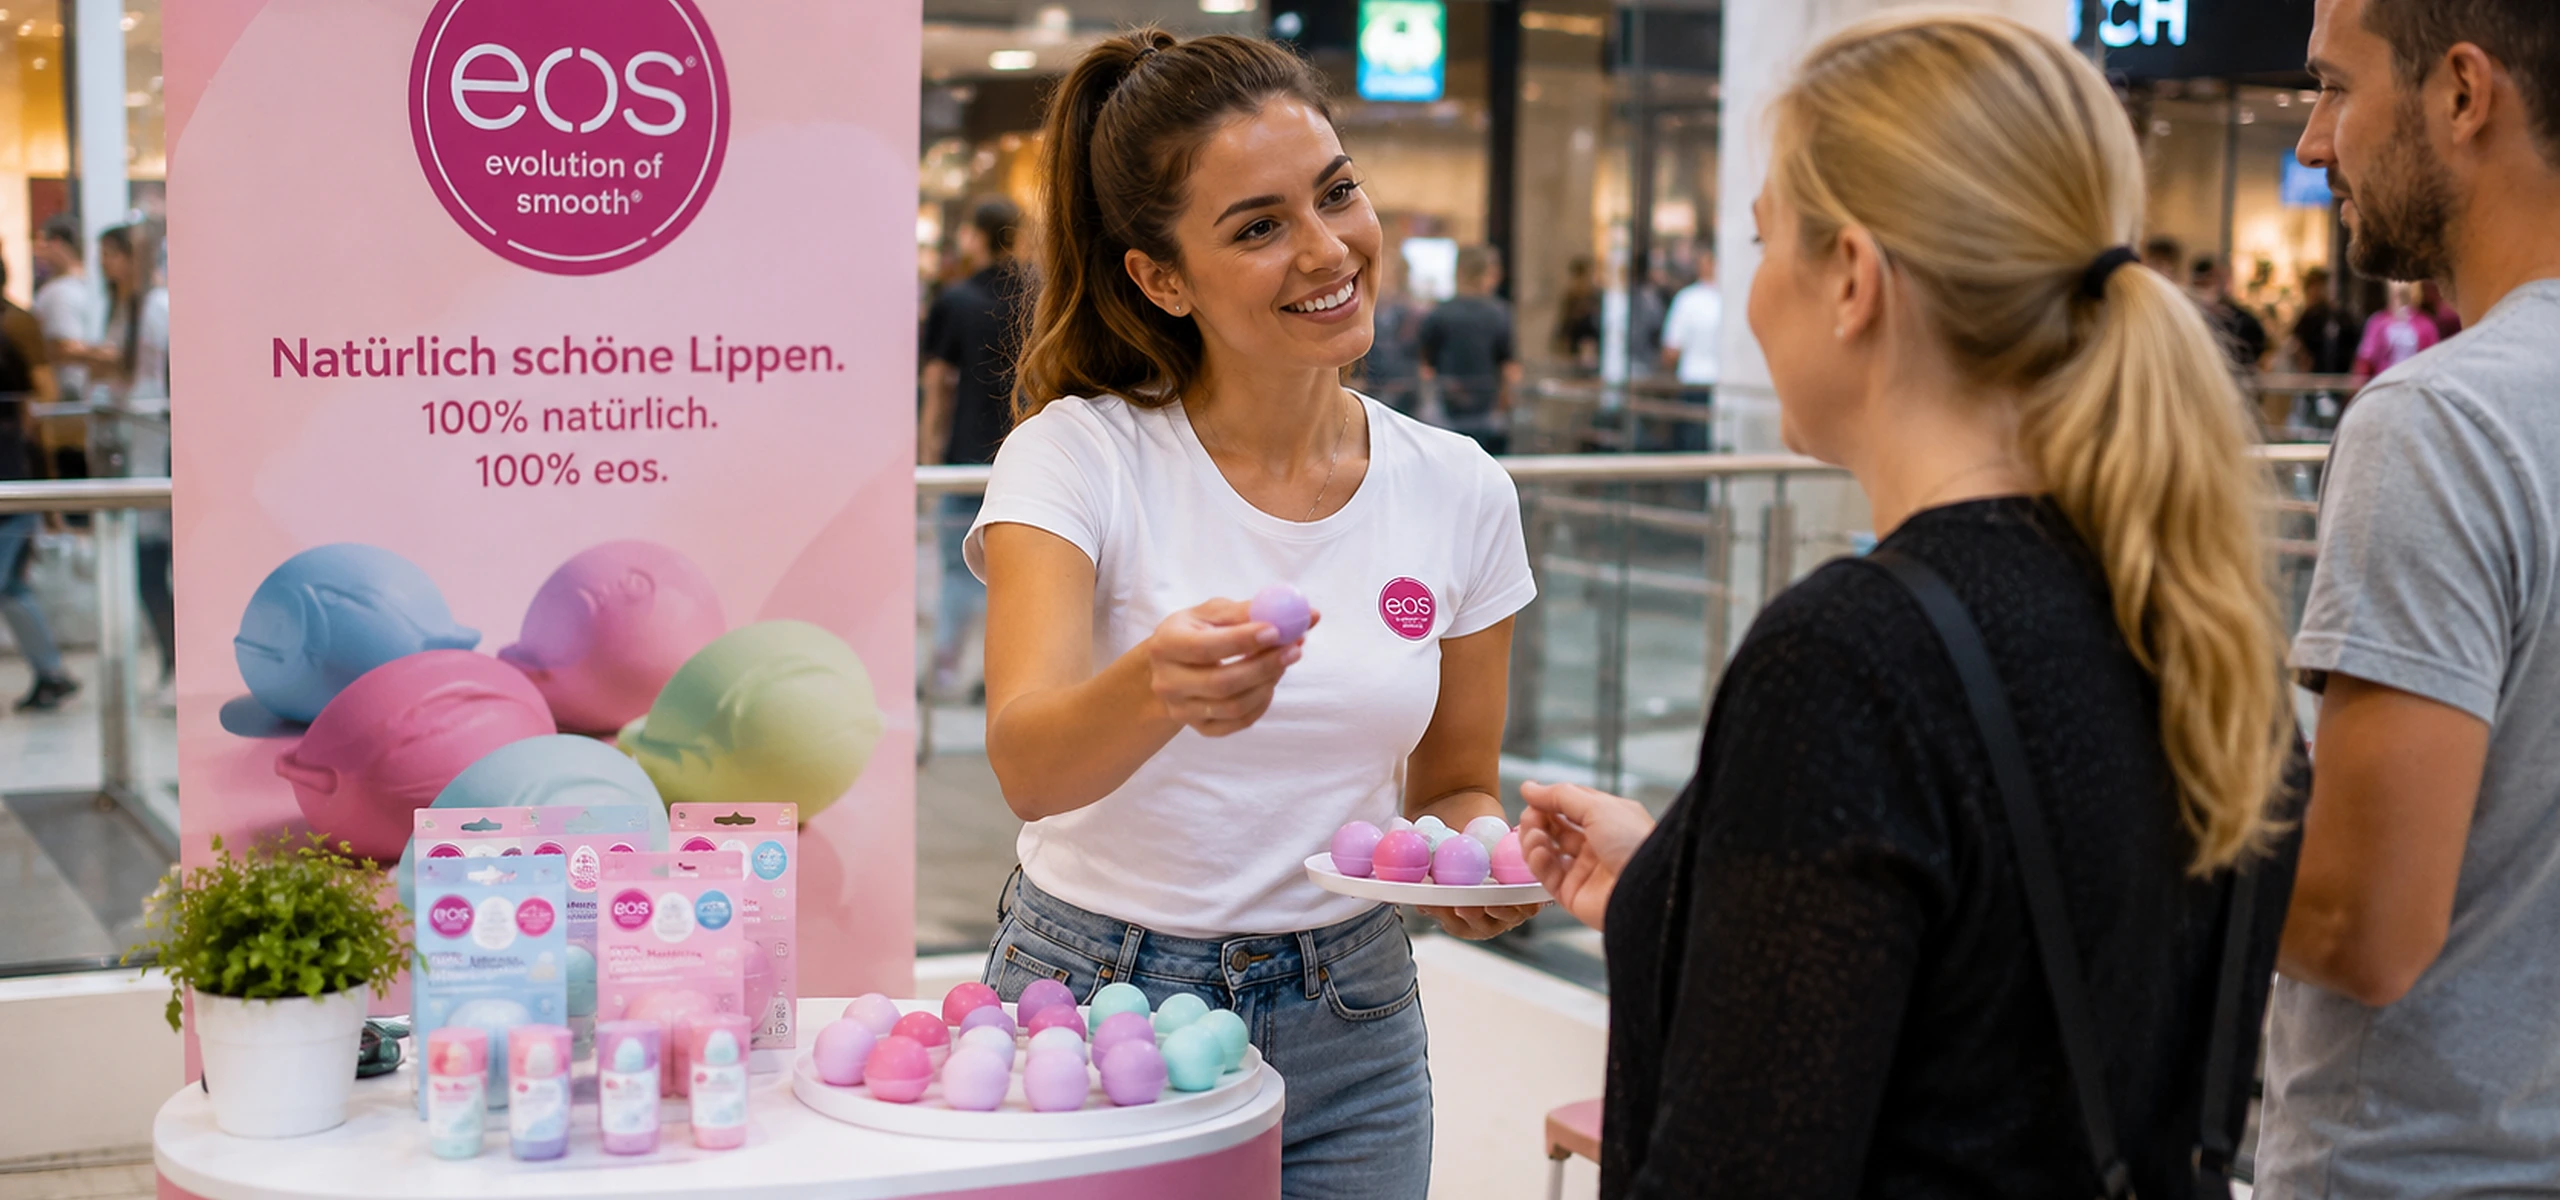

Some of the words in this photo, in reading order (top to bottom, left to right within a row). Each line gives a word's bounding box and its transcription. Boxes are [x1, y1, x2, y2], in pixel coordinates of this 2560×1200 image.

[485, 149, 625, 179] evolution
[633, 152, 664, 180] of
[272, 335, 497, 378] Natürlich
[512, 335, 674, 376] schöne
[690, 334, 845, 383] Lippen.
[421, 399, 529, 435] 100%
[543, 396, 718, 432] natürlich.
[475, 452, 581, 487] 100%
[594, 458, 668, 484] eos.
[1385, 596, 1431, 615] eos
[614, 901, 650, 916] eos
